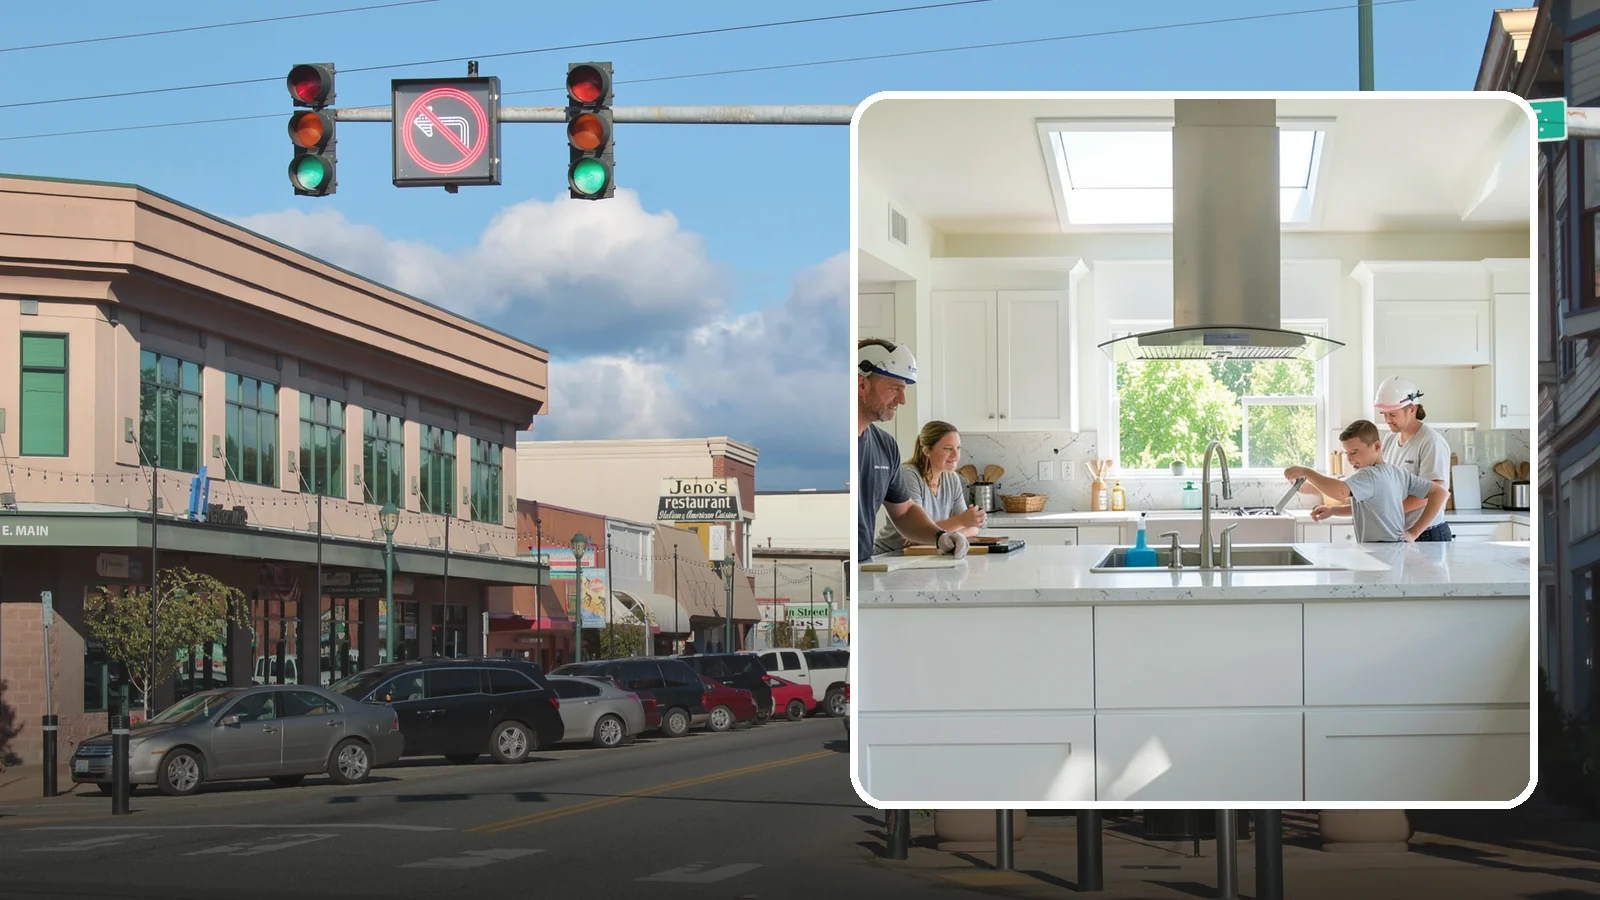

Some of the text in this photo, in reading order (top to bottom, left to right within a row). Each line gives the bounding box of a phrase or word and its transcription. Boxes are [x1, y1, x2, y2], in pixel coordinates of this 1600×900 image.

[670, 480, 728, 495] Jeno's
[665, 496, 731, 509] restaurant
[658, 509, 681, 519] Italian
[686, 509, 715, 519] American
[715, 509, 738, 519] Cuisine
[2, 525, 49, 536] E. MAIN
[797, 607, 828, 617] Street
